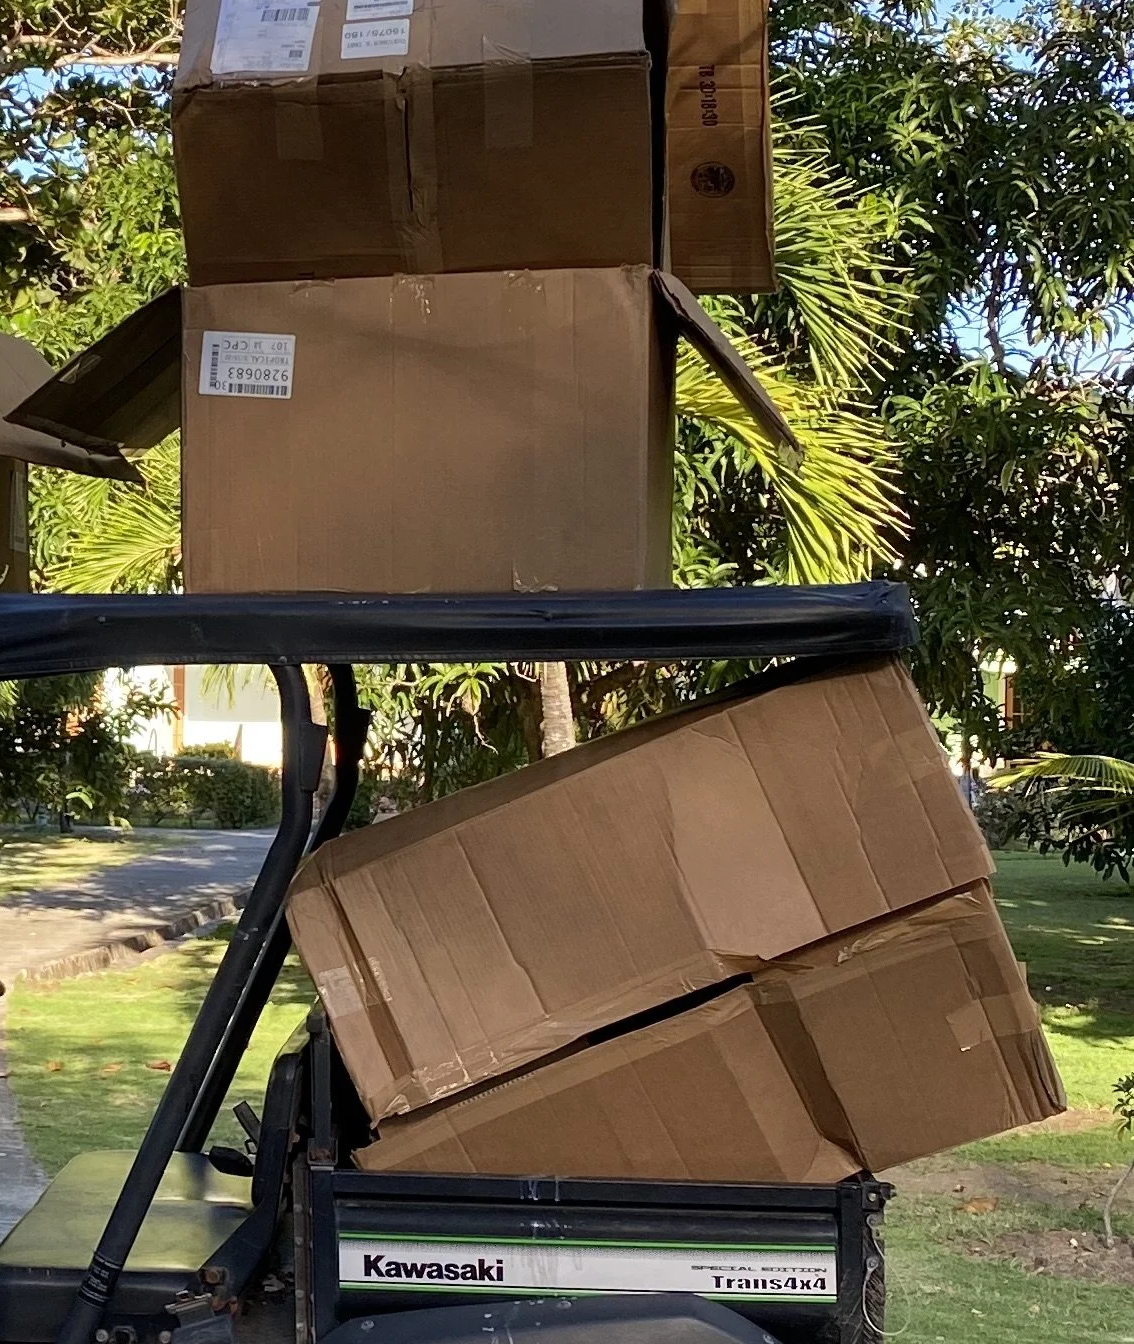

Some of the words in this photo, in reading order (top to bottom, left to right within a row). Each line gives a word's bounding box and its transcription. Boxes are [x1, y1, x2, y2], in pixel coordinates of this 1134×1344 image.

[698, 64, 715, 77] TB
[223, 339, 249, 351] CPC
[250, 355, 289, 365] TROPICAL
[228, 367, 289, 382] 9280683
[363, 1254, 504, 1282] Kawasaki
[711, 1275, 827, 1291] Trans4x4
